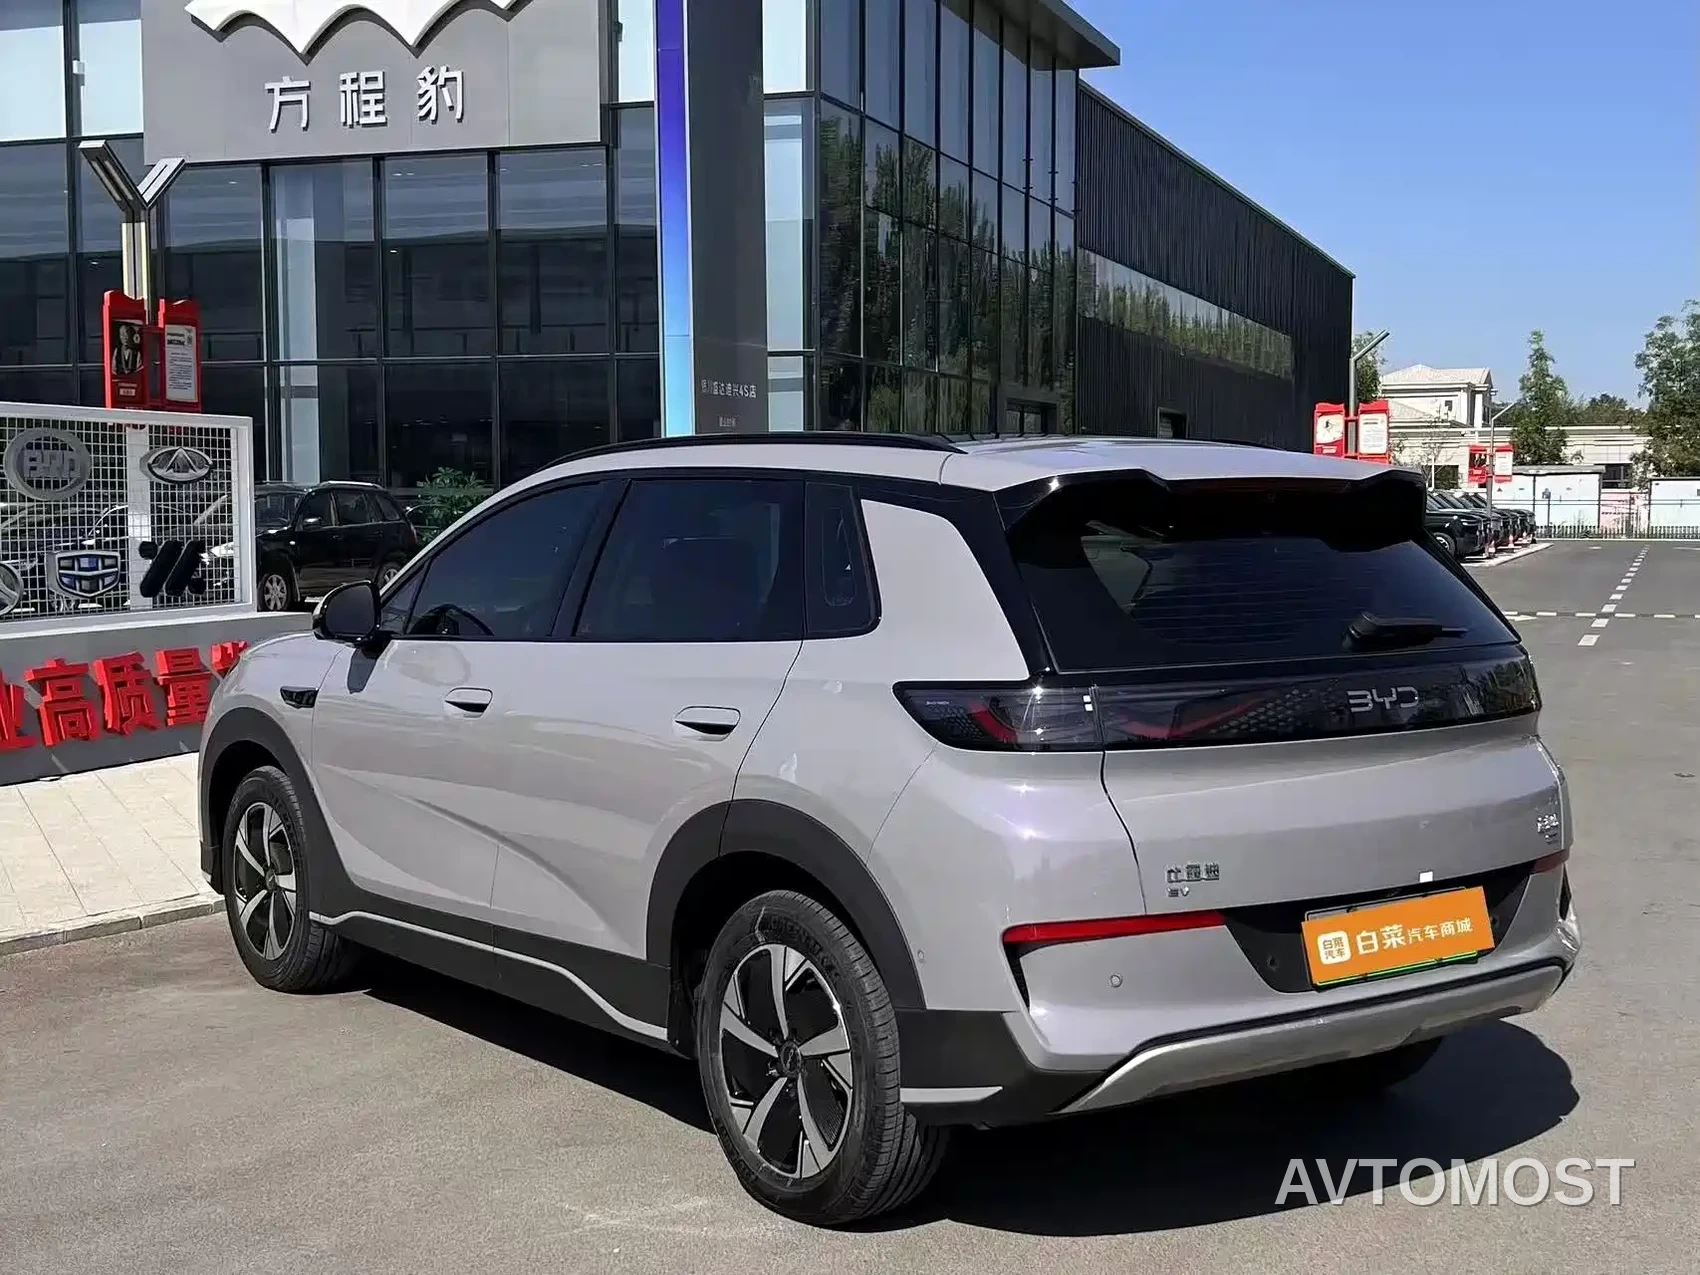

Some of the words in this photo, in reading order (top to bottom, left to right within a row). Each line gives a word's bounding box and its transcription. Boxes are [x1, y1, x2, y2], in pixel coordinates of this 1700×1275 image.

[264, 65, 464, 133] 方程豹
[0, 641, 248, 750] 业高质量
[1346, 685, 1419, 713] BYD
[1356, 918, 1473, 955] 白菜汽车商城
